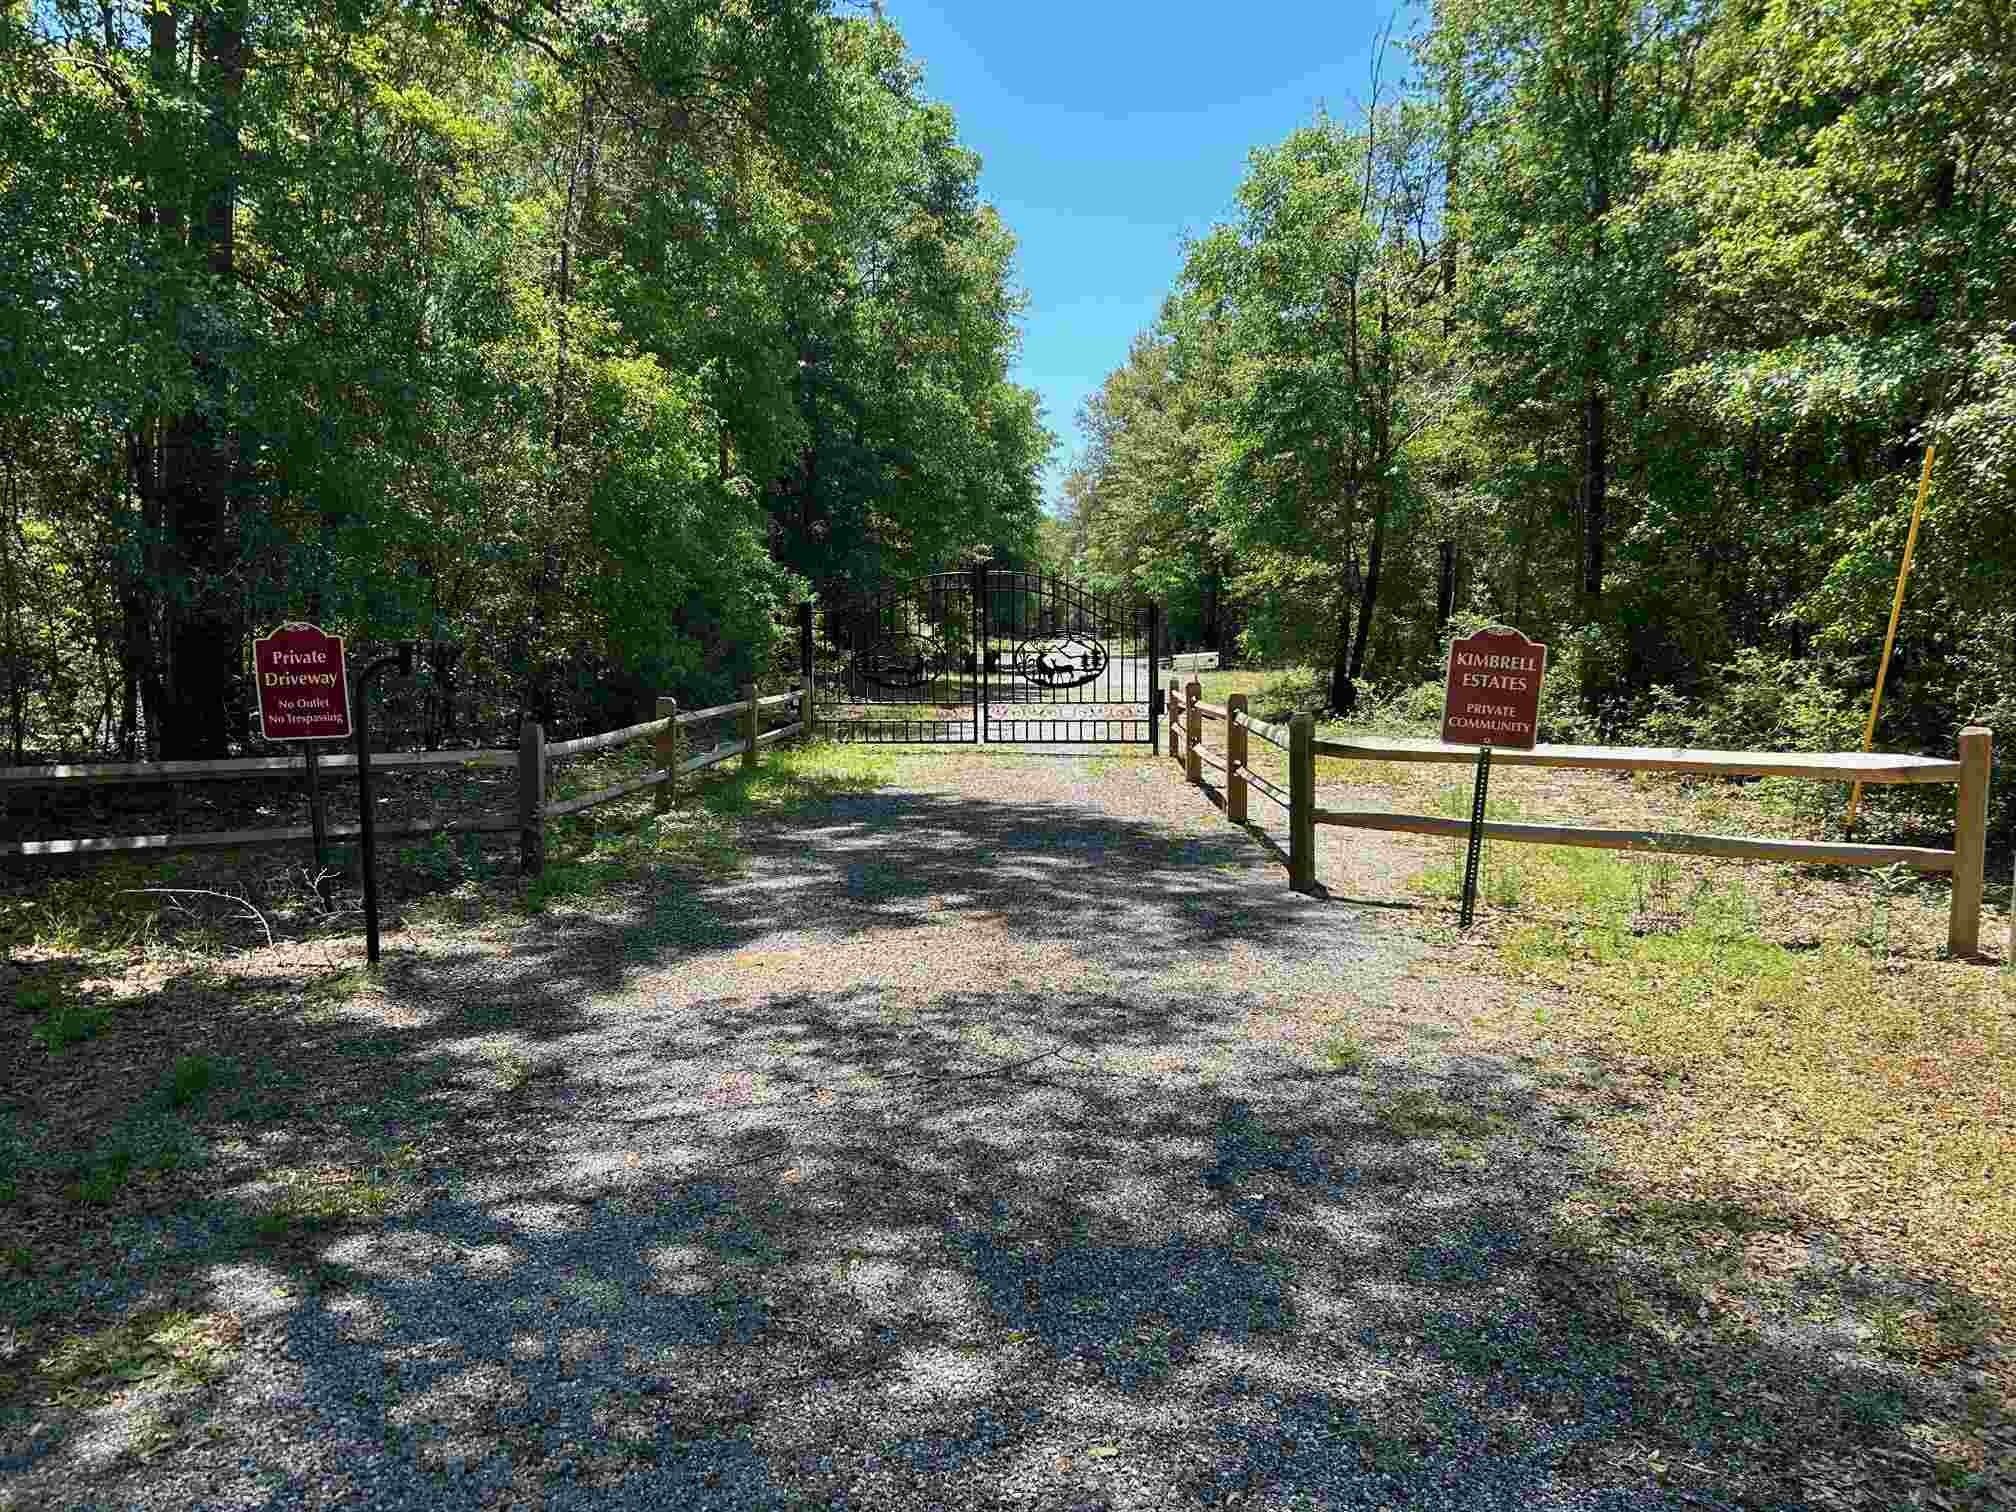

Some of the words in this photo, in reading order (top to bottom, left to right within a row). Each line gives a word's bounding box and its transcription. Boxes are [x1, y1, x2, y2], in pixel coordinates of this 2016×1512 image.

[272, 650, 327, 665] Private
[1457, 652, 1537, 672] KIMBRELL
[264, 671, 338, 688] Driveway
[1463, 673, 1528, 691] ESTATES
[279, 698, 295, 709] No
[297, 697, 329, 709] Outlet
[1466, 703, 1517, 718] PRIVATE
[269, 713, 285, 724] No
[287, 712, 344, 725] Trespassing
[1449, 716, 1531, 733] COMMUNITY
